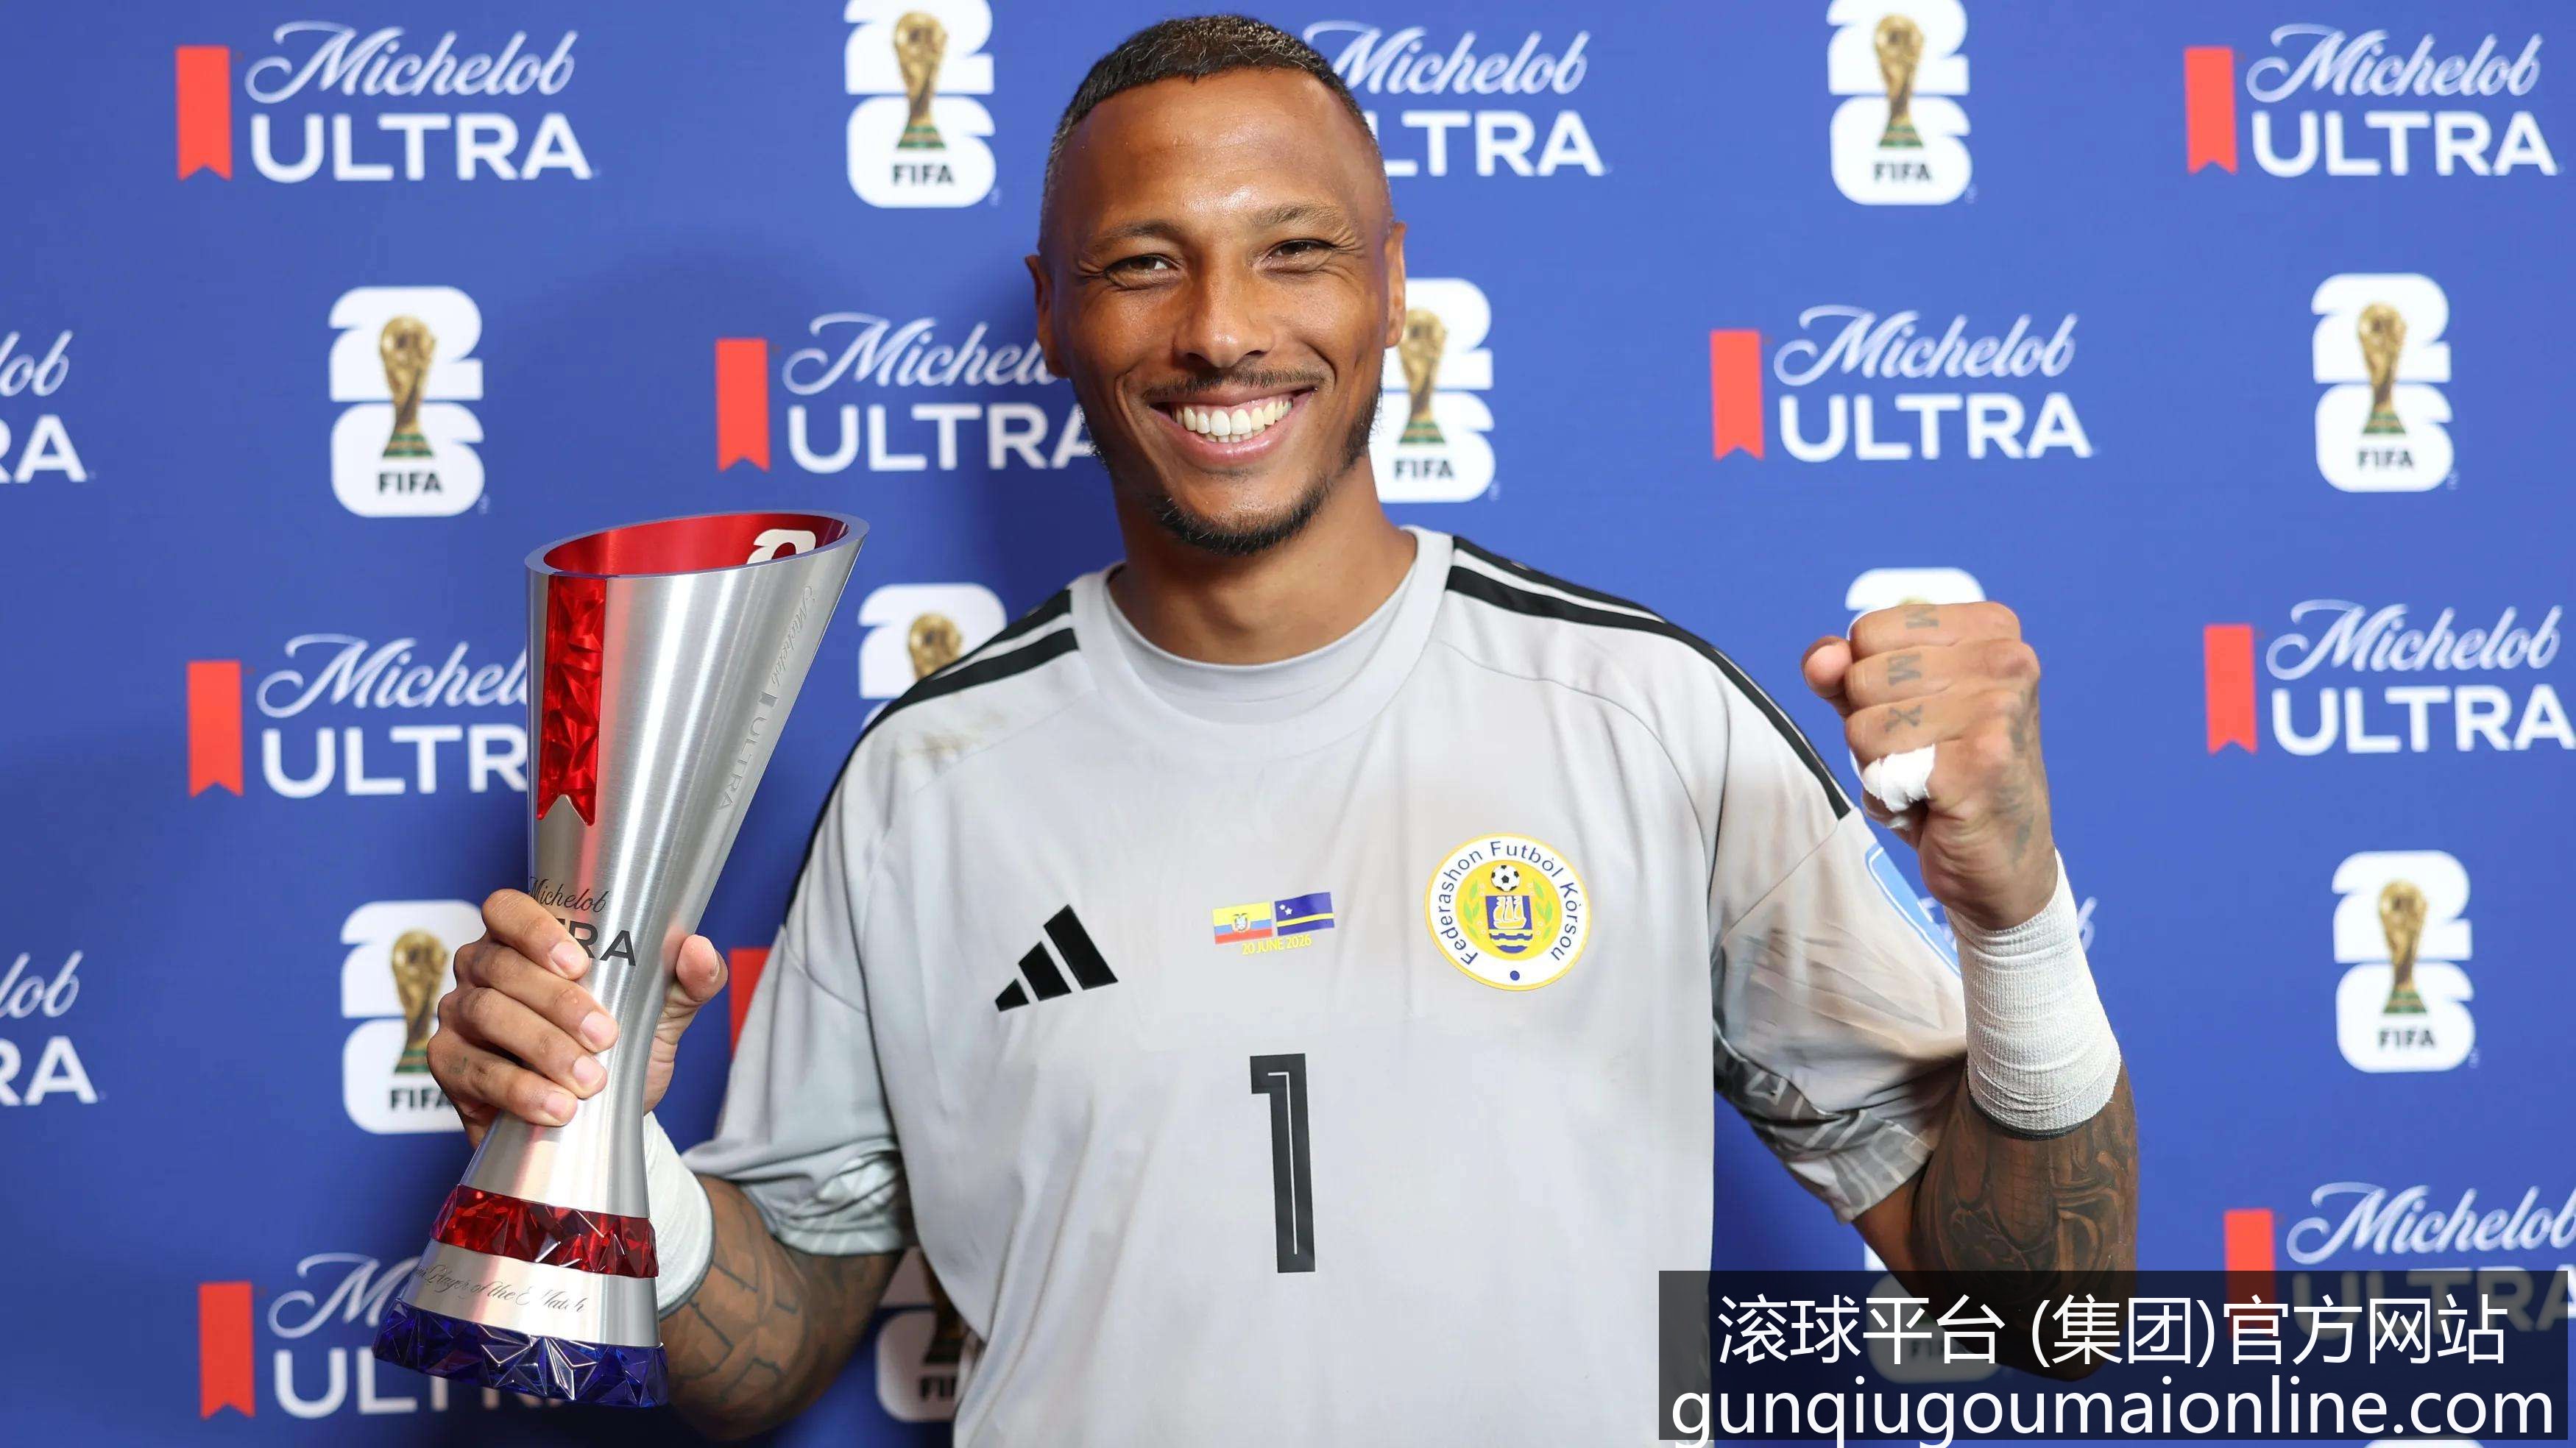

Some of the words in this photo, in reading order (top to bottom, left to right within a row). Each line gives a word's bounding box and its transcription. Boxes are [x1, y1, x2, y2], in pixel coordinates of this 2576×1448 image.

[245, 21, 578, 104] Michelob
[1302, 20, 1590, 95] Michelob
[2246, 23, 2543, 103] Michelob
[251, 113, 592, 182] ULTRA
[892, 163, 955, 185] FIFA
[1874, 161, 1931, 181] FIFA
[2252, 110, 2558, 177] ULTRA
[1773, 304, 2078, 386] Michelob
[1779, 393, 2092, 462] ULTRA
[2357, 448, 2415, 469] FIFA
[378, 471, 443, 494] FIFA
[1394, 458, 1455, 479] FIFA
[2265, 598, 2563, 681] Michelob
[256, 634, 526, 719] Michel
[2271, 684, 2576, 756] ULTRA
[262, 724, 528, 798] ULTR
[721, 716, 767, 808] ULTRA
[529, 876, 610, 913] Michelob
[1438, 850, 1483, 966] Federashon
[1242, 943, 1254, 955] 20
[1257, 938, 1284, 954] JUNE
[1287, 934, 1312, 950] 2026
[2379, 1028, 2436, 1048] FIFA
[1250, 1054, 1315, 1273] 1
[2286, 1181, 2576, 1265] Michelob
